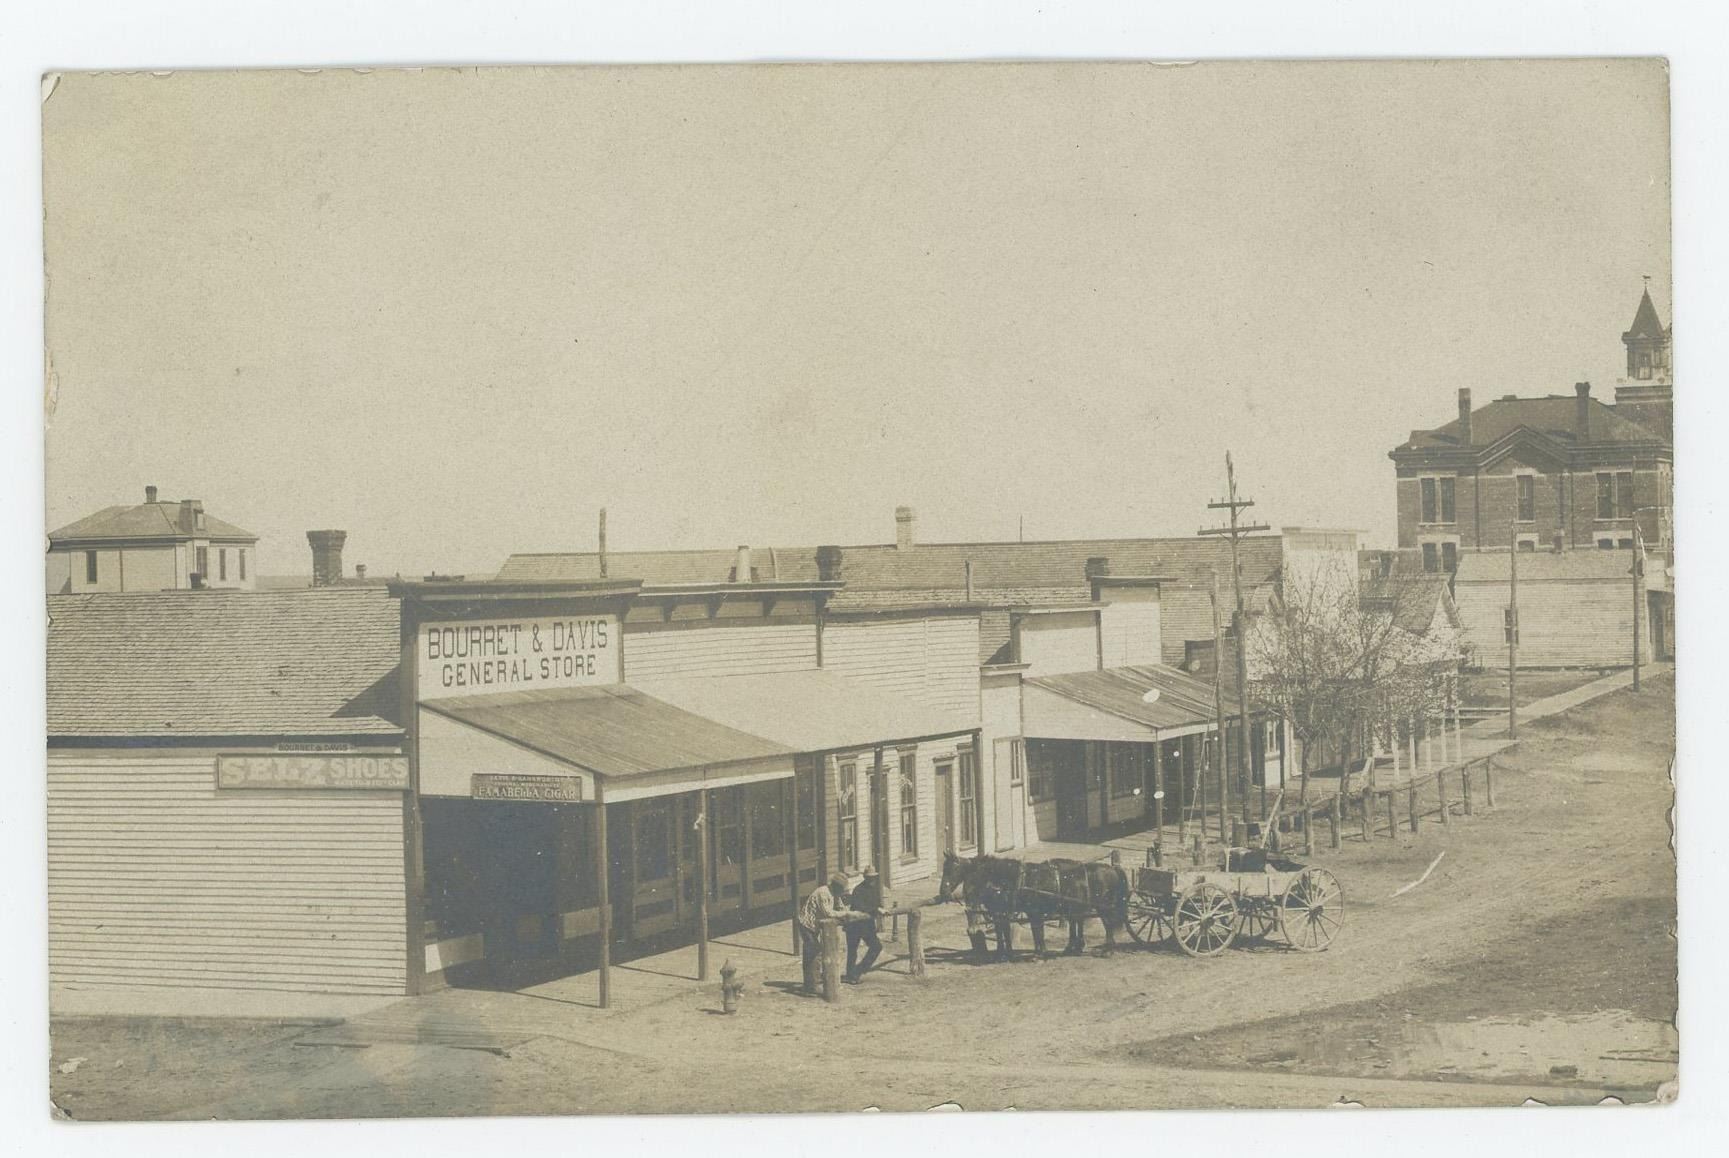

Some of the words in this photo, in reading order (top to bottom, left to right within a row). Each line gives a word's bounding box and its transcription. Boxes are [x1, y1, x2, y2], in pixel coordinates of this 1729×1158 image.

[428, 624, 522, 660] BOURRET
[532, 623, 543, 653] &
[553, 619, 607, 651] DAVIS
[442, 658, 533, 688] GENERAL
[540, 654, 597, 680] STORE
[221, 756, 328, 786] SELZ
[329, 756, 409, 779] SHOES
[544, 788, 577, 800] CIGAR
